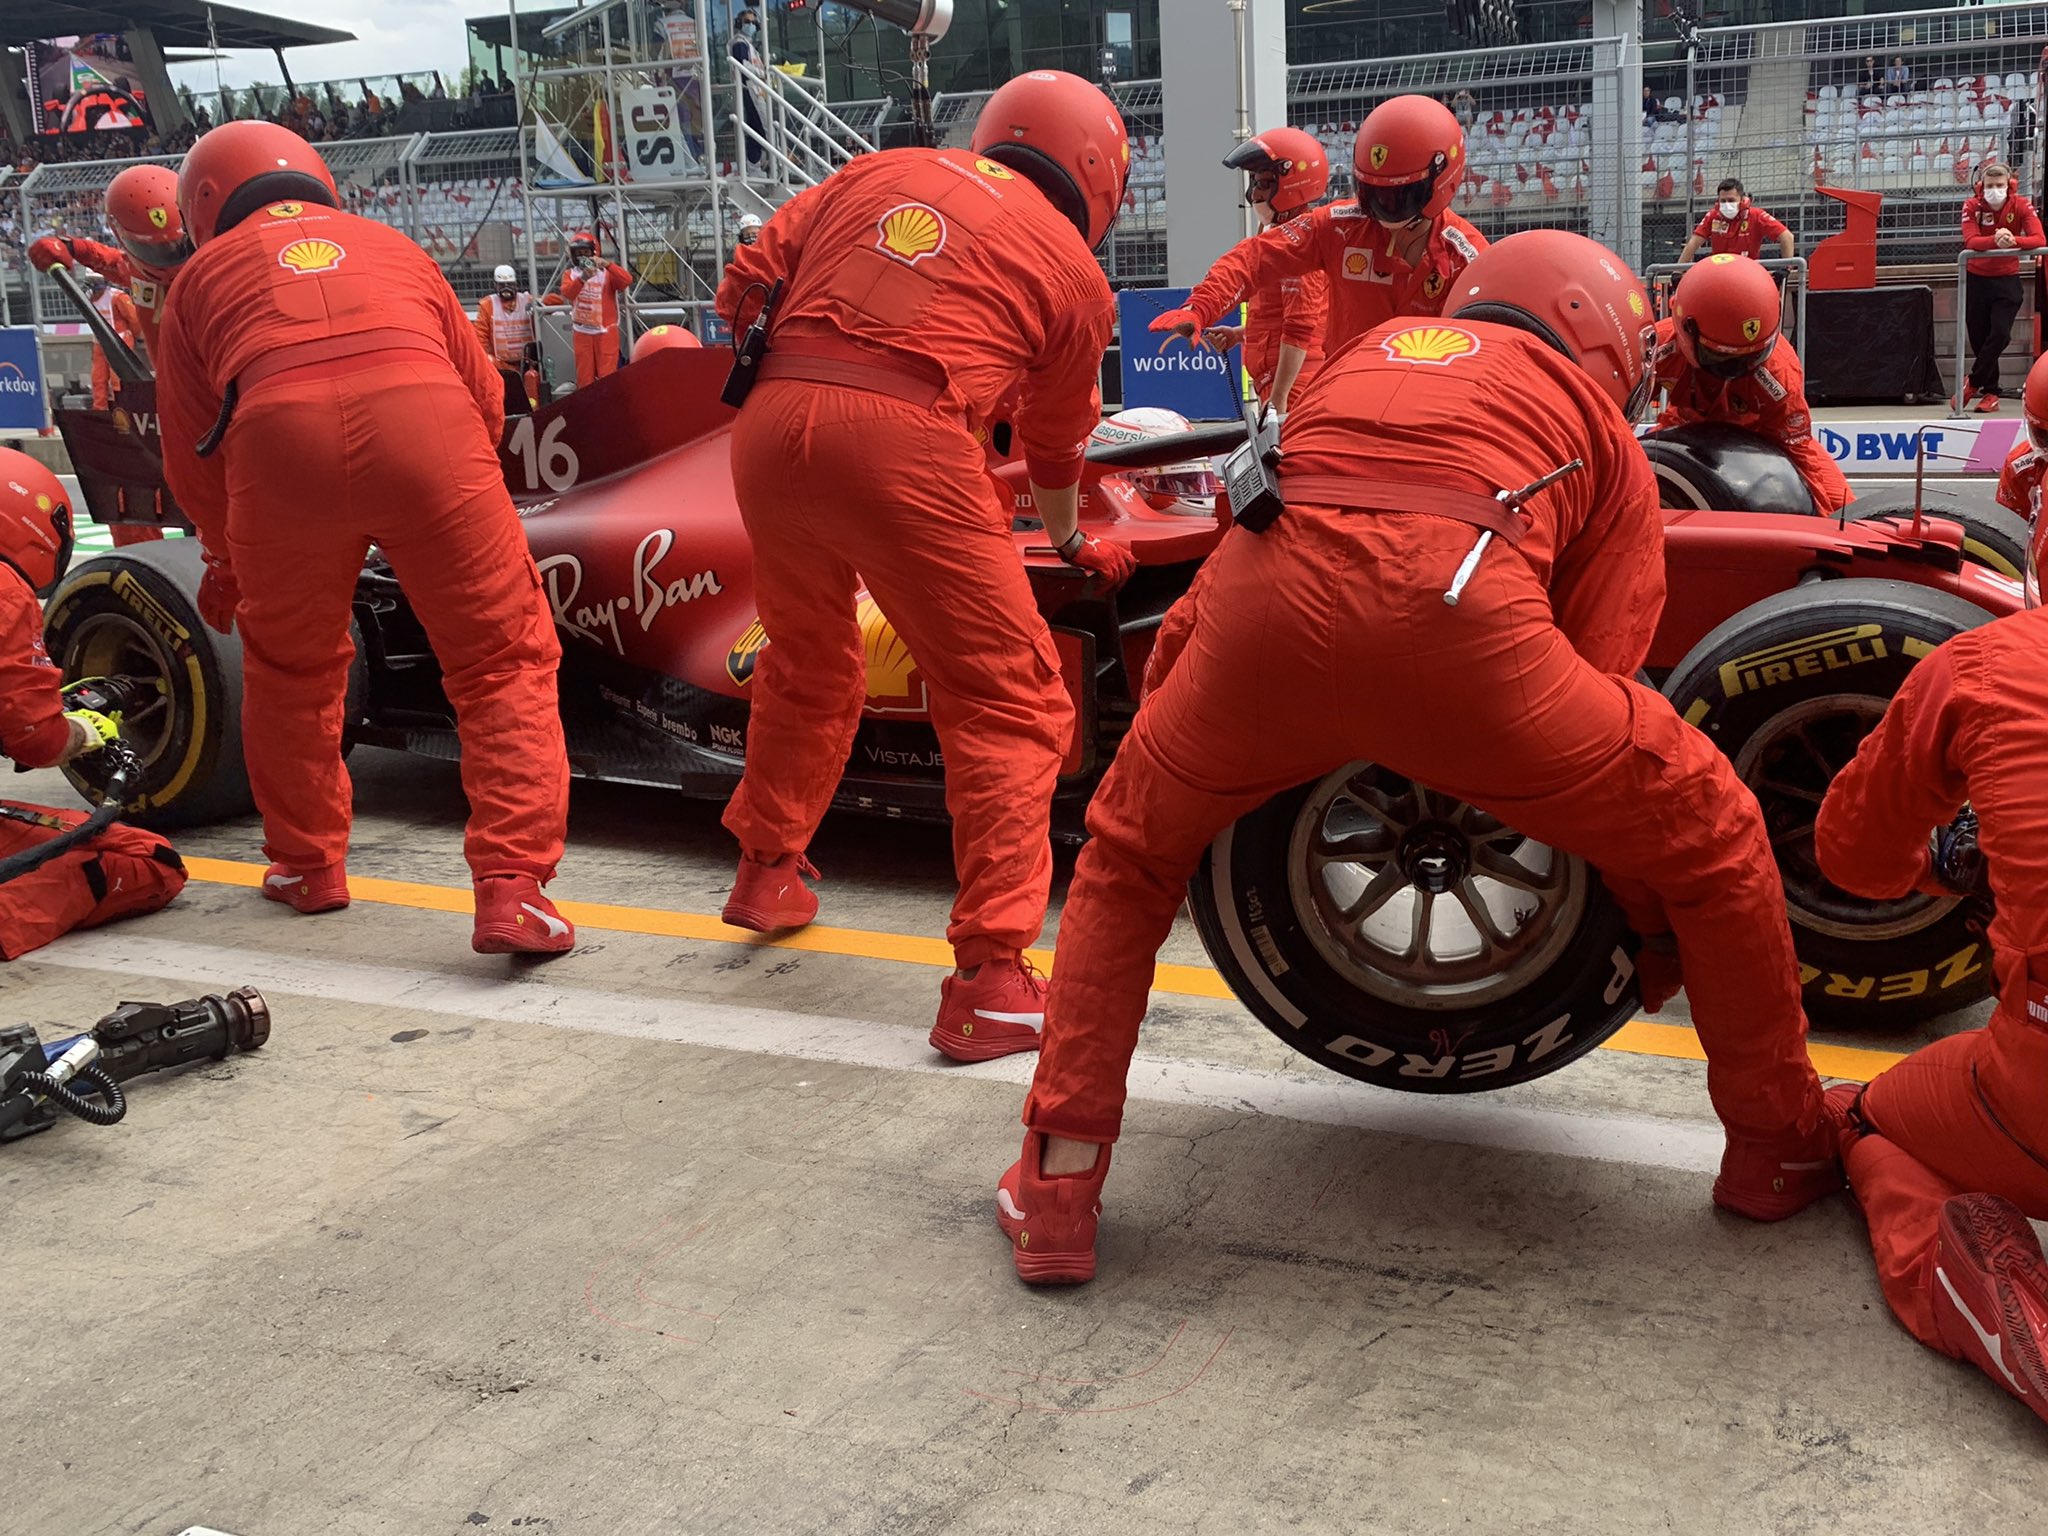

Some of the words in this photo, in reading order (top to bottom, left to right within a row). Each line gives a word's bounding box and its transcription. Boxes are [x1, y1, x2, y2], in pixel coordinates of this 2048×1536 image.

[631, 103, 675, 166] SC
[1133, 350, 1227, 375] workday
[1605, 302, 1628, 347] RICHARD
[1624, 348, 1635, 379] MILLE
[0, 377, 36, 396] rkday
[508, 415, 579, 492] 16
[1856, 432, 1943, 461] BWT
[112, 569, 190, 652] PIRELLI
[1719, 624, 1888, 698] PIRELLI
[662, 713, 698, 741] brembo
[710, 724, 743, 747] NGK
[865, 745, 944, 767] VISTAJE
[1604, 945, 1634, 1005] P
[1325, 1013, 1573, 1079] ZERO
